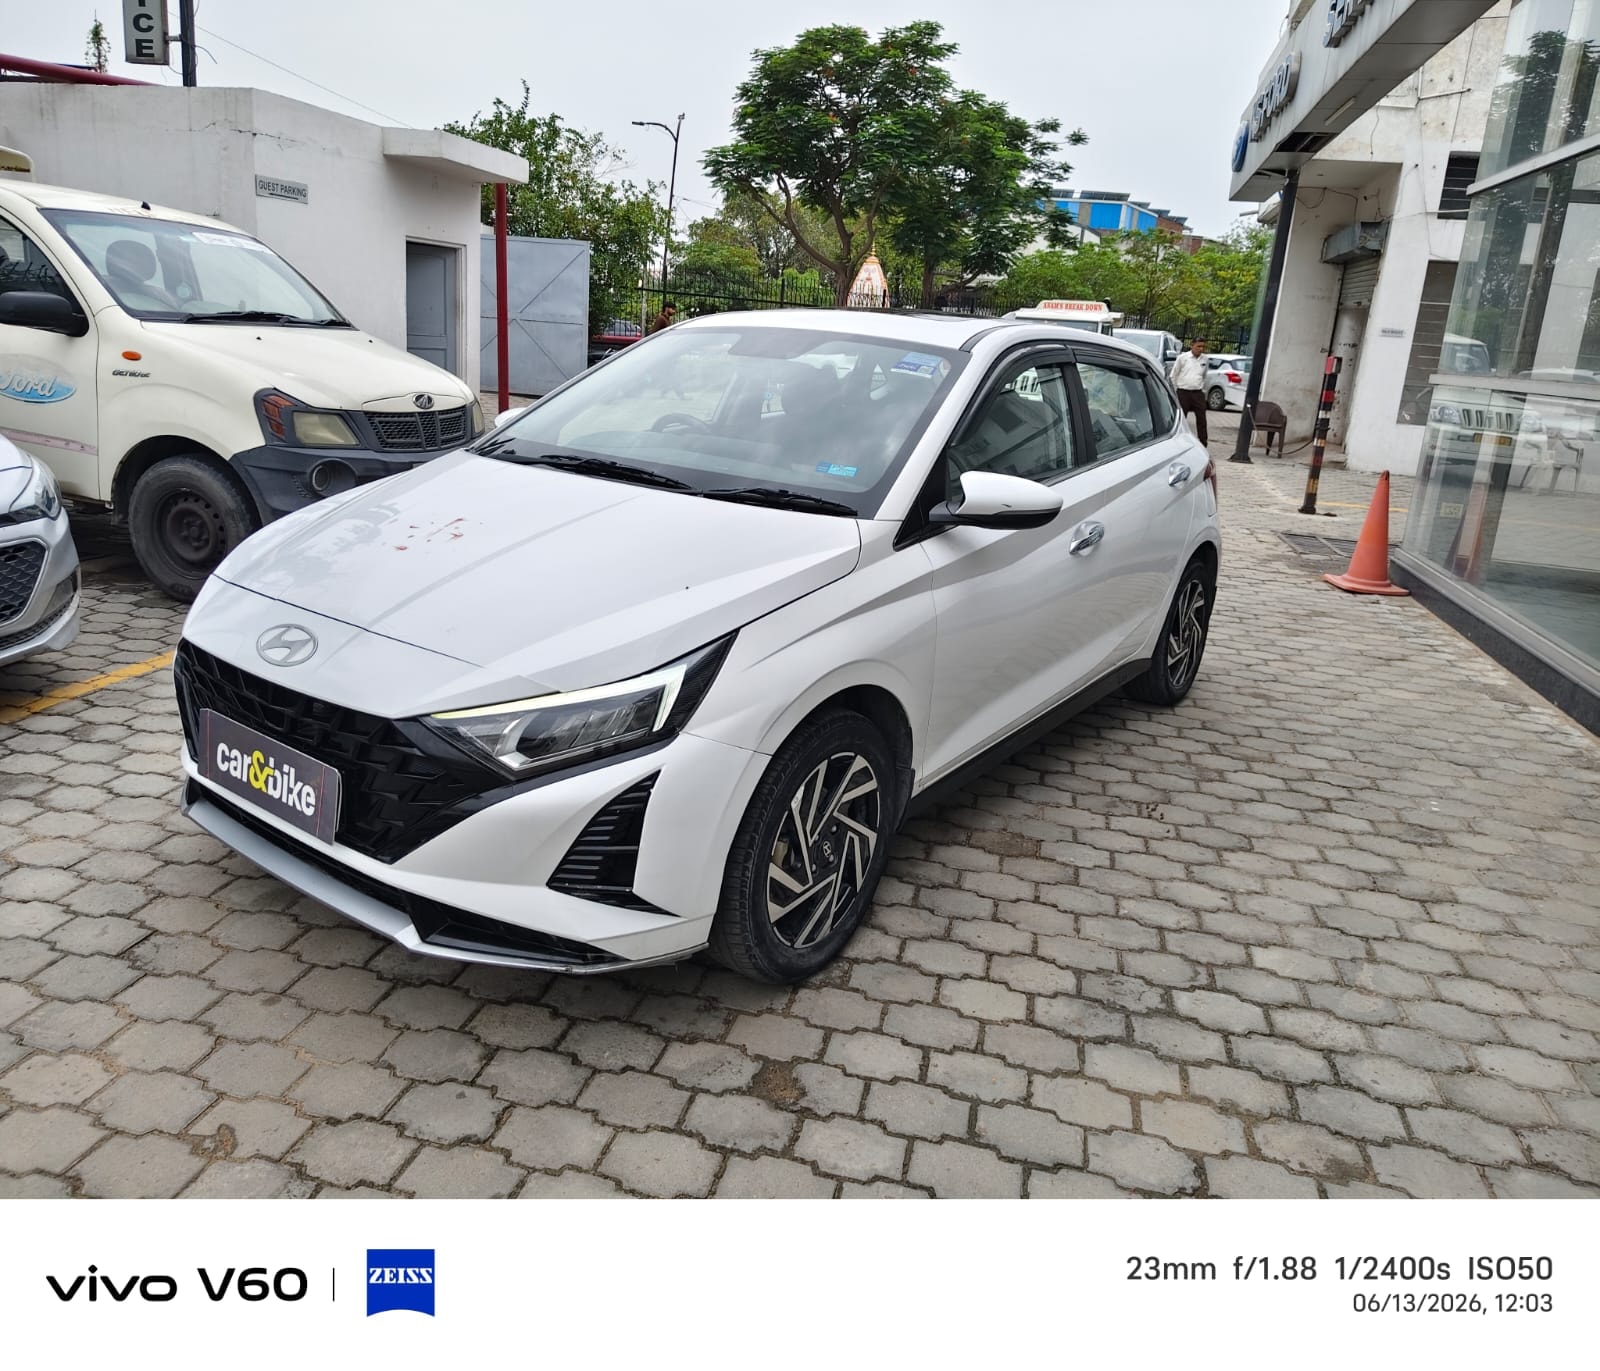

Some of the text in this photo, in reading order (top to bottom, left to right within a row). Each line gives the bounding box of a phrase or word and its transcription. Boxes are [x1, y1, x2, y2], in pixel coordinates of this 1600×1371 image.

[258, 179, 307, 198] GUEST PARKING
[1085, 303, 1103, 311] DOWN
[216, 742, 316, 816] car&bike
